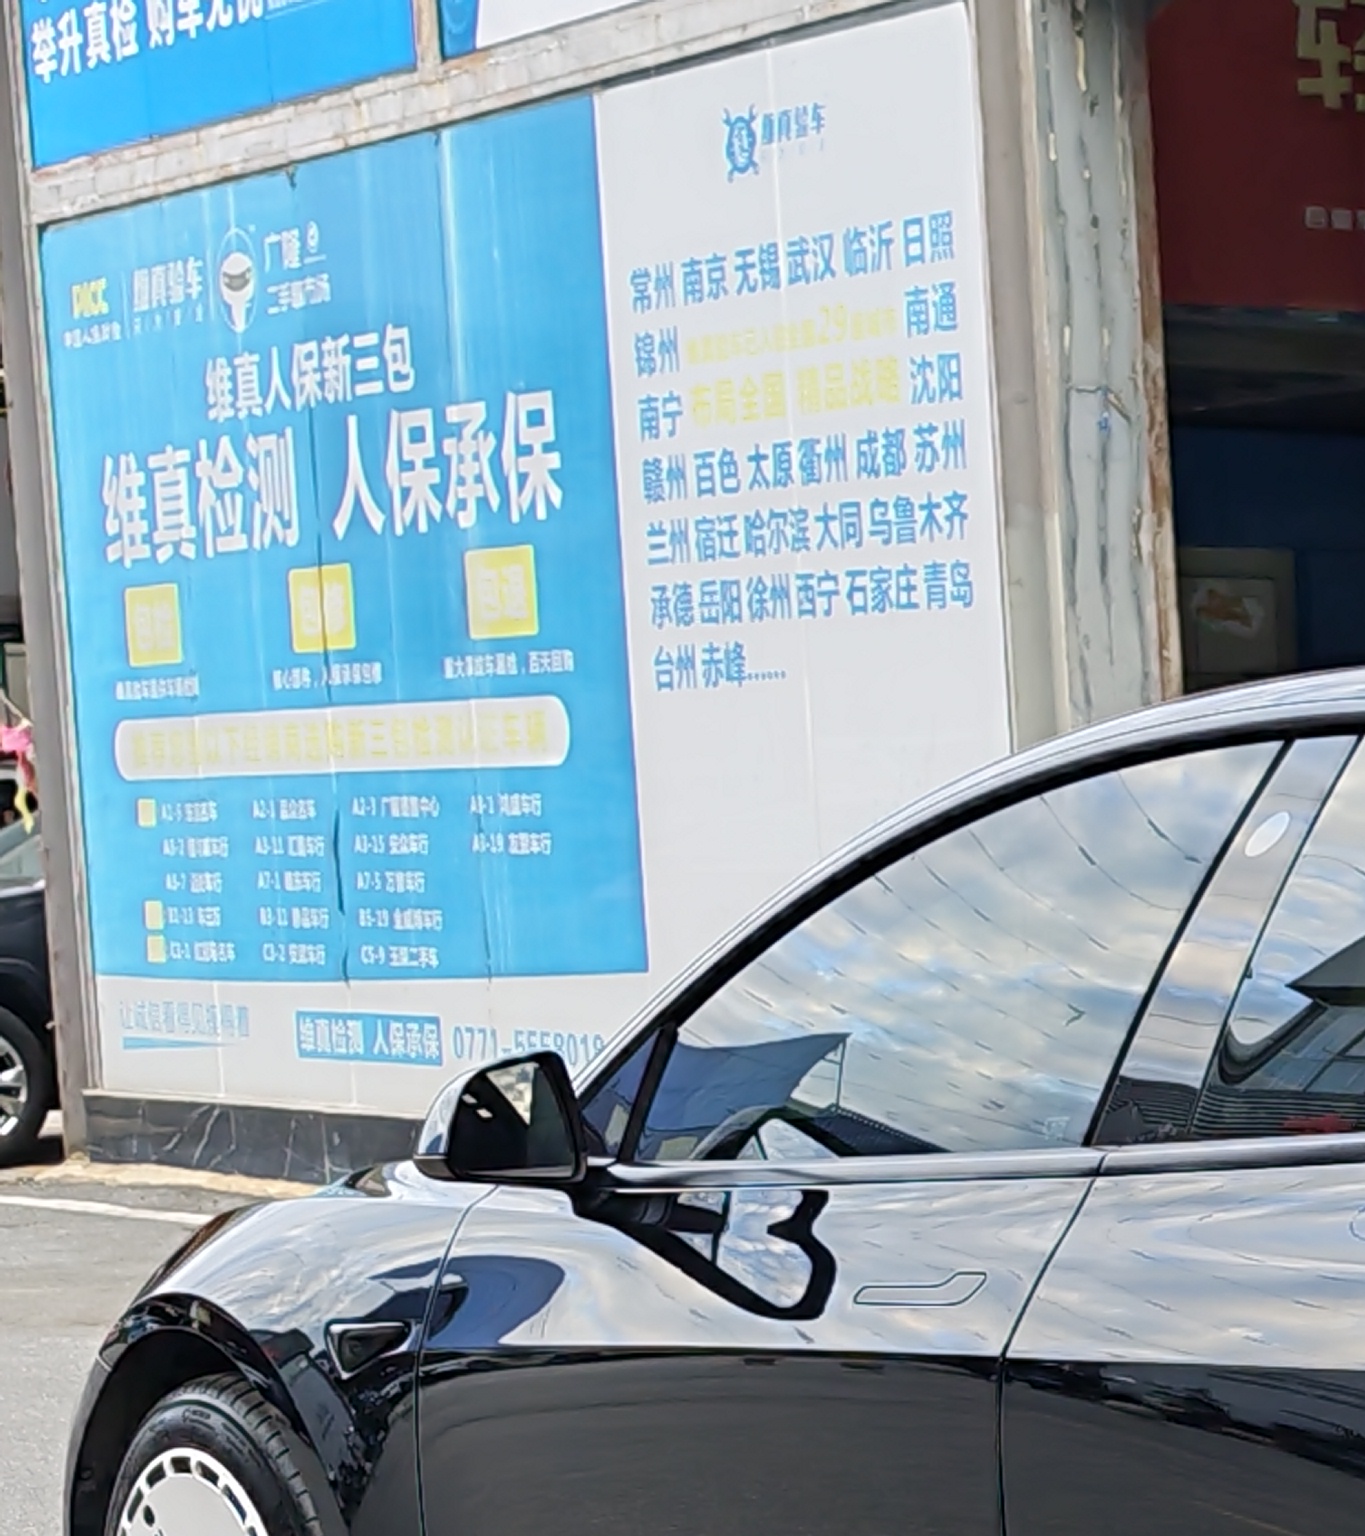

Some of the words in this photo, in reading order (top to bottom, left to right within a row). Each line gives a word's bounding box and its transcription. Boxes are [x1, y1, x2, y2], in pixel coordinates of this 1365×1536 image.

[31, 1, 140, 84] 举升真检
[629, 261, 676, 313] 常州
[680, 253, 728, 305] 南京
[733, 242, 781, 296] 无锡
[786, 233, 837, 287] 武汉
[842, 220, 894, 277] 临沂
[902, 210, 955, 267] 日照
[633, 326, 680, 378] 锦州
[904, 281, 957, 337] 南通
[205, 324, 415, 422] 维真人保新三包
[637, 391, 683, 442] 南宁
[910, 352, 963, 404] 沈阳
[103, 426, 299, 568] 维真检测
[333, 389, 563, 541] 人保承保
[643, 453, 688, 504] 赣州
[693, 447, 741, 498] 百色
[746, 440, 795, 492] 太原
[798, 433, 849, 486] 衢州
[856, 427, 907, 479] 成都
[913, 418, 967, 474] 苏州
[647, 517, 691, 566] 兰州
[694, 514, 741, 563] 宿迁
[744, 505, 810, 558] 哈尔滨
[814, 501, 864, 552] 大同
[868, 489, 969, 546] 乌鲁木齐
[651, 581, 695, 629] 承德
[698, 578, 743, 626] 岳阳
[746, 573, 793, 623] 徐州
[795, 569, 840, 619] 西宁
[845, 563, 921, 616] 石家庄
[923, 559, 974, 610] 青岛
[653, 644, 697, 692] 台州
[299, 1018, 363, 1055] 维真检测
[373, 1020, 440, 1060] 人保承保
